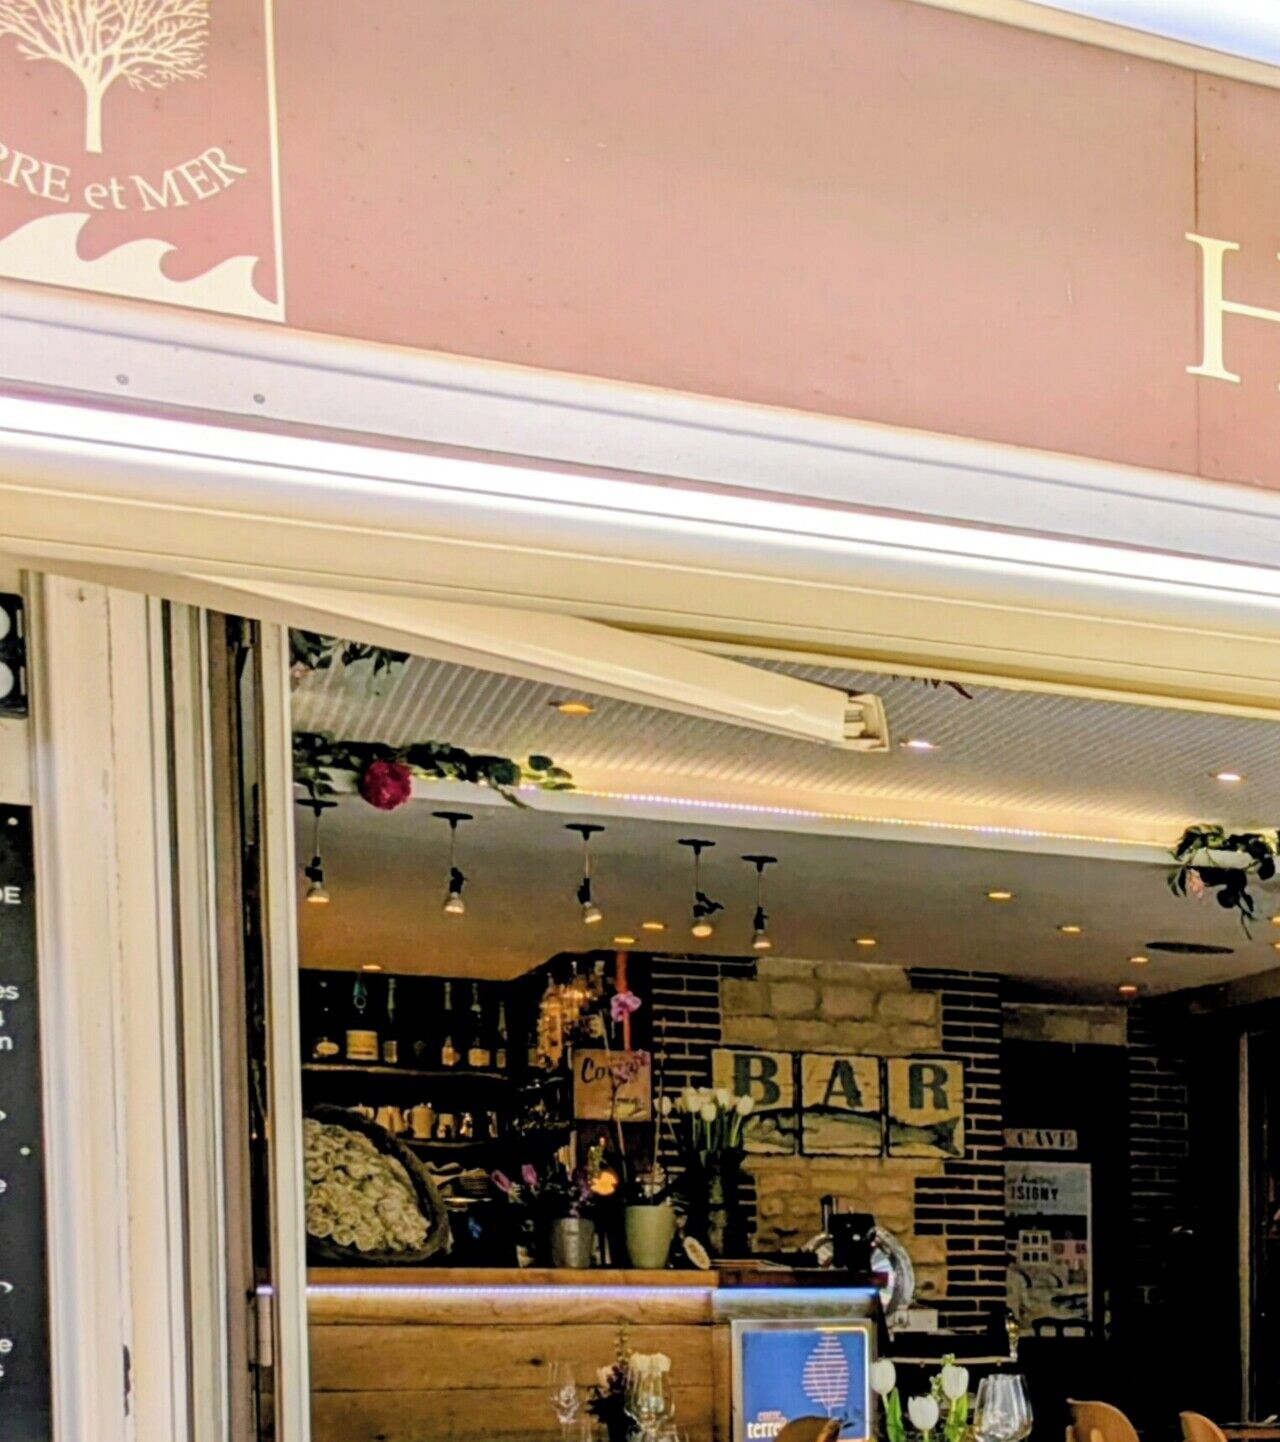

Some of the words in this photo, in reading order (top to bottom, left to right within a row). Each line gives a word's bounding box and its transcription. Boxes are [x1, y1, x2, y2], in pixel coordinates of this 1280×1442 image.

[84, 177, 127, 210] et
[129, 147, 247, 211] MER
[732, 1054, 952, 1110] BAR
